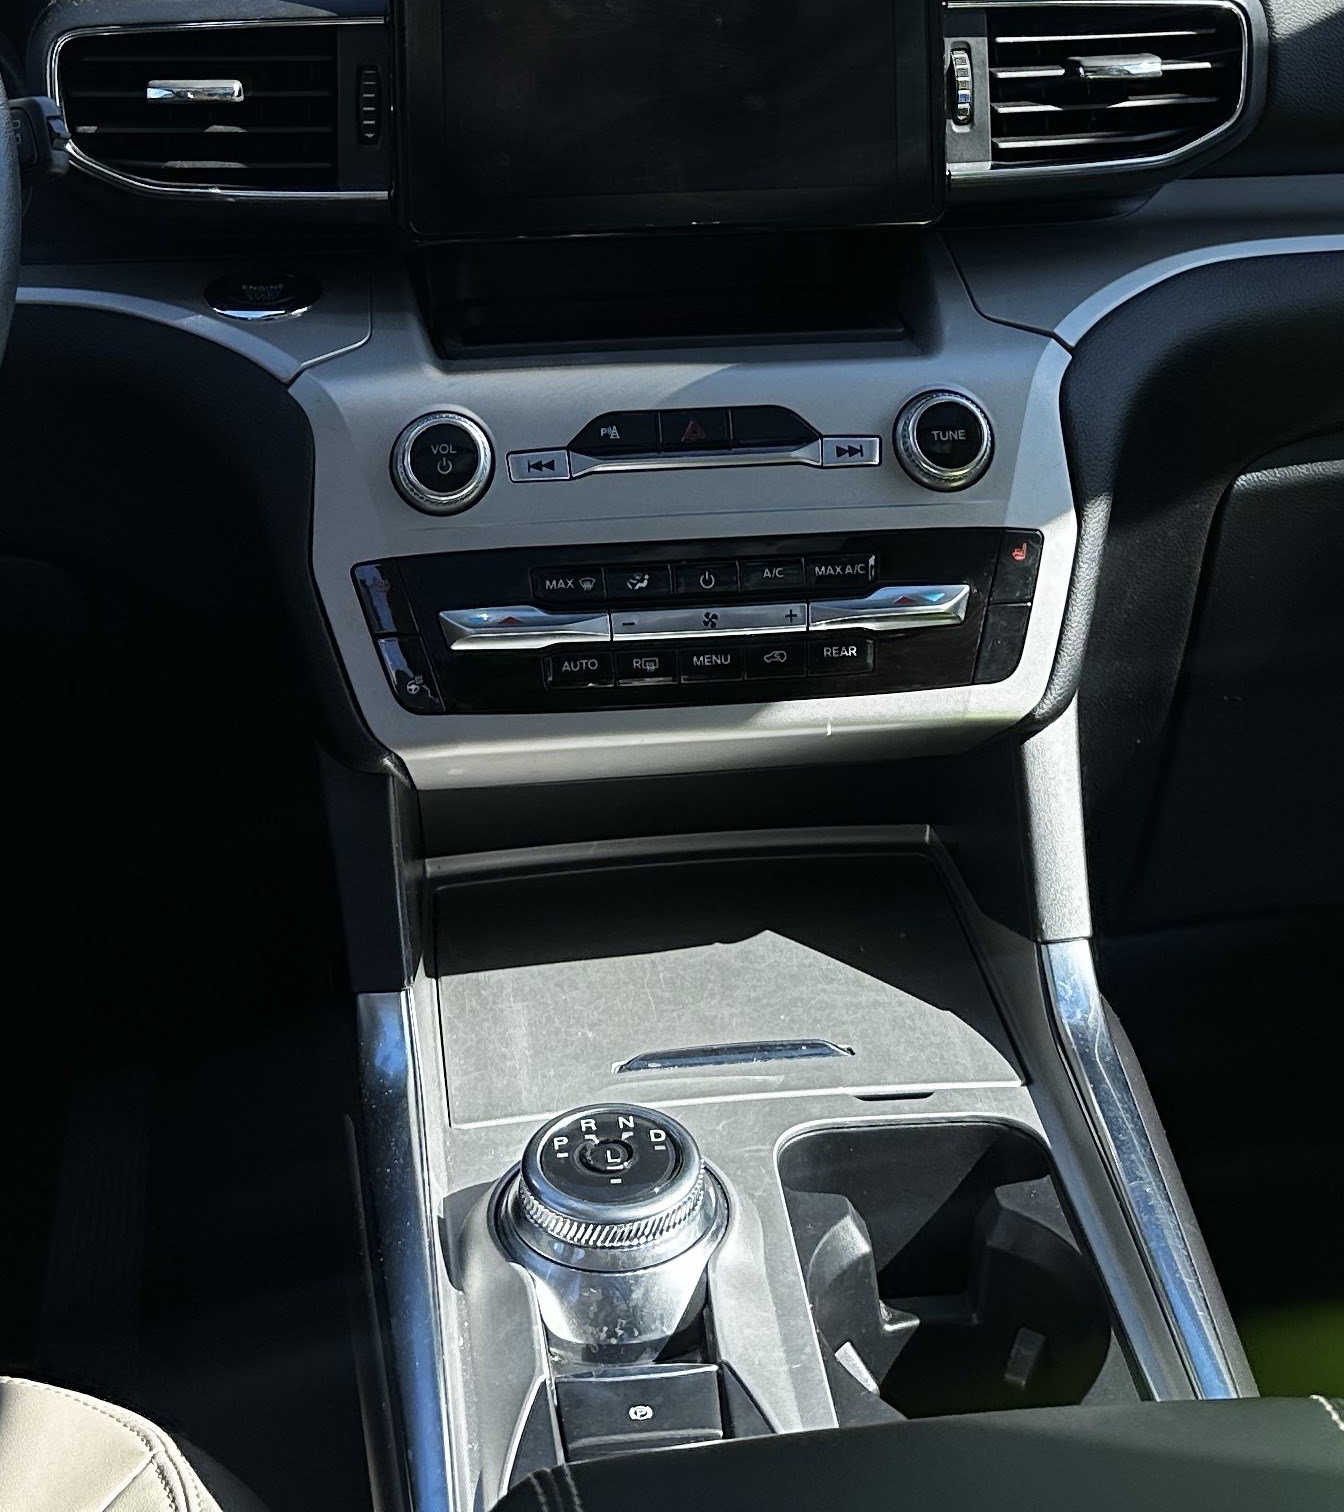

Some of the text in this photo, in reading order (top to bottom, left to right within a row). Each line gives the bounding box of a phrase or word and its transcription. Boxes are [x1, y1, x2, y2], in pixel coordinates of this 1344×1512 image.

[931, 428, 967, 442] TUNE
[430, 443, 458, 455] VOL
[762, 567, 785, 579] A/C
[815, 562, 866, 577] MAX A/C
[545, 577, 575, 590] MAX
[823, 644, 858, 658] REAR
[562, 658, 599, 672] AUTO
[693, 653, 731, 666] MENU
[580, 1118, 598, 1132] R
[618, 1115, 635, 1129] N
[649, 1129, 667, 1142] D
[552, 1136, 569, 1150] P
[606, 1149, 622, 1163] L
